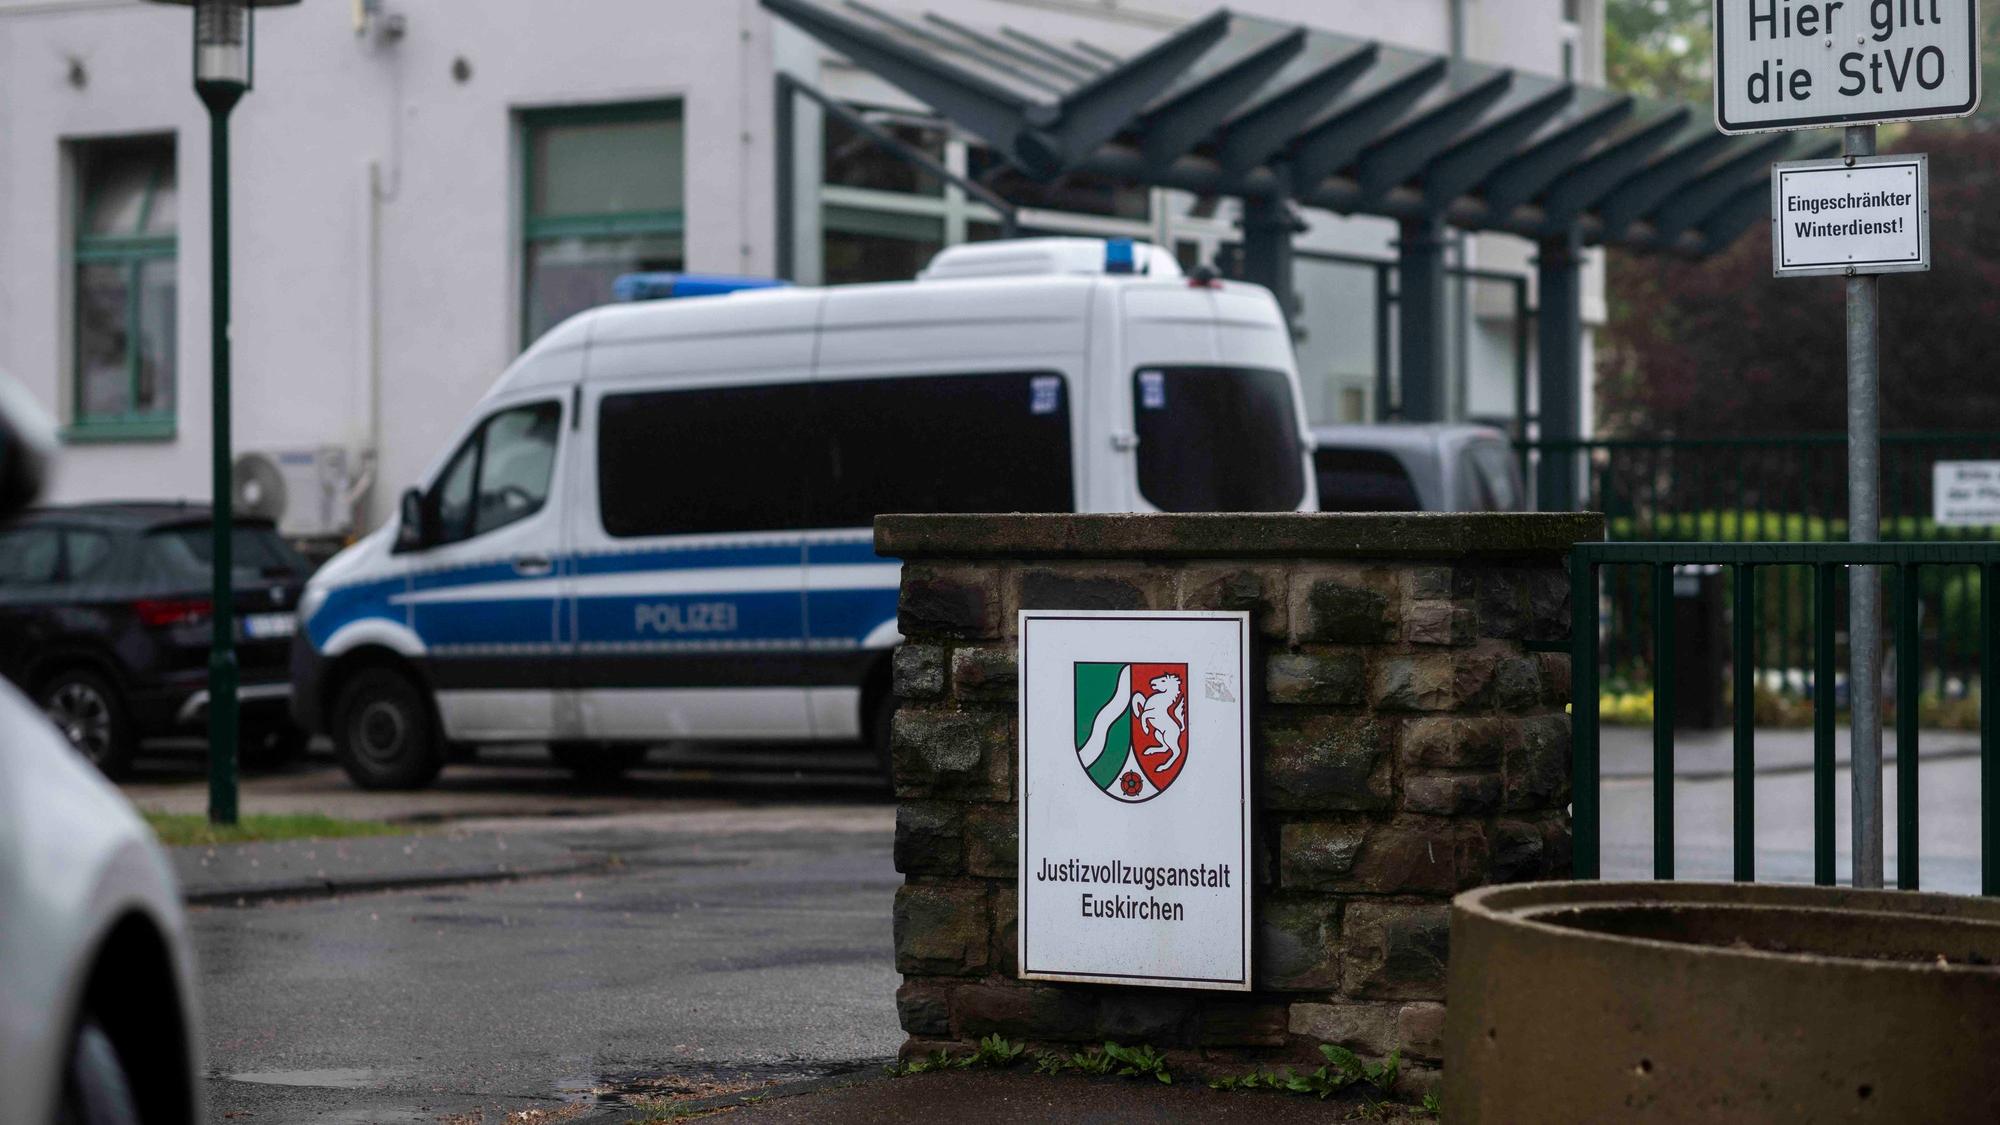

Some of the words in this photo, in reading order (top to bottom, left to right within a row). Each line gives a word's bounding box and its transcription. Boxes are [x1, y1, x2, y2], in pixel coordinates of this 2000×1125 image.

[1750, 0, 1844, 41] Hier
[1747, 59, 1812, 104] die
[1838, 45, 1945, 96] StVO
[1787, 190, 1912, 214] Eingeschränkter
[1794, 216, 1903, 239] Winterdienst!
[635, 602, 738, 633] POLIZEI
[1036, 857, 1231, 889] Justizvollzugsanstalt
[1081, 893, 1184, 921] Euskirchen
